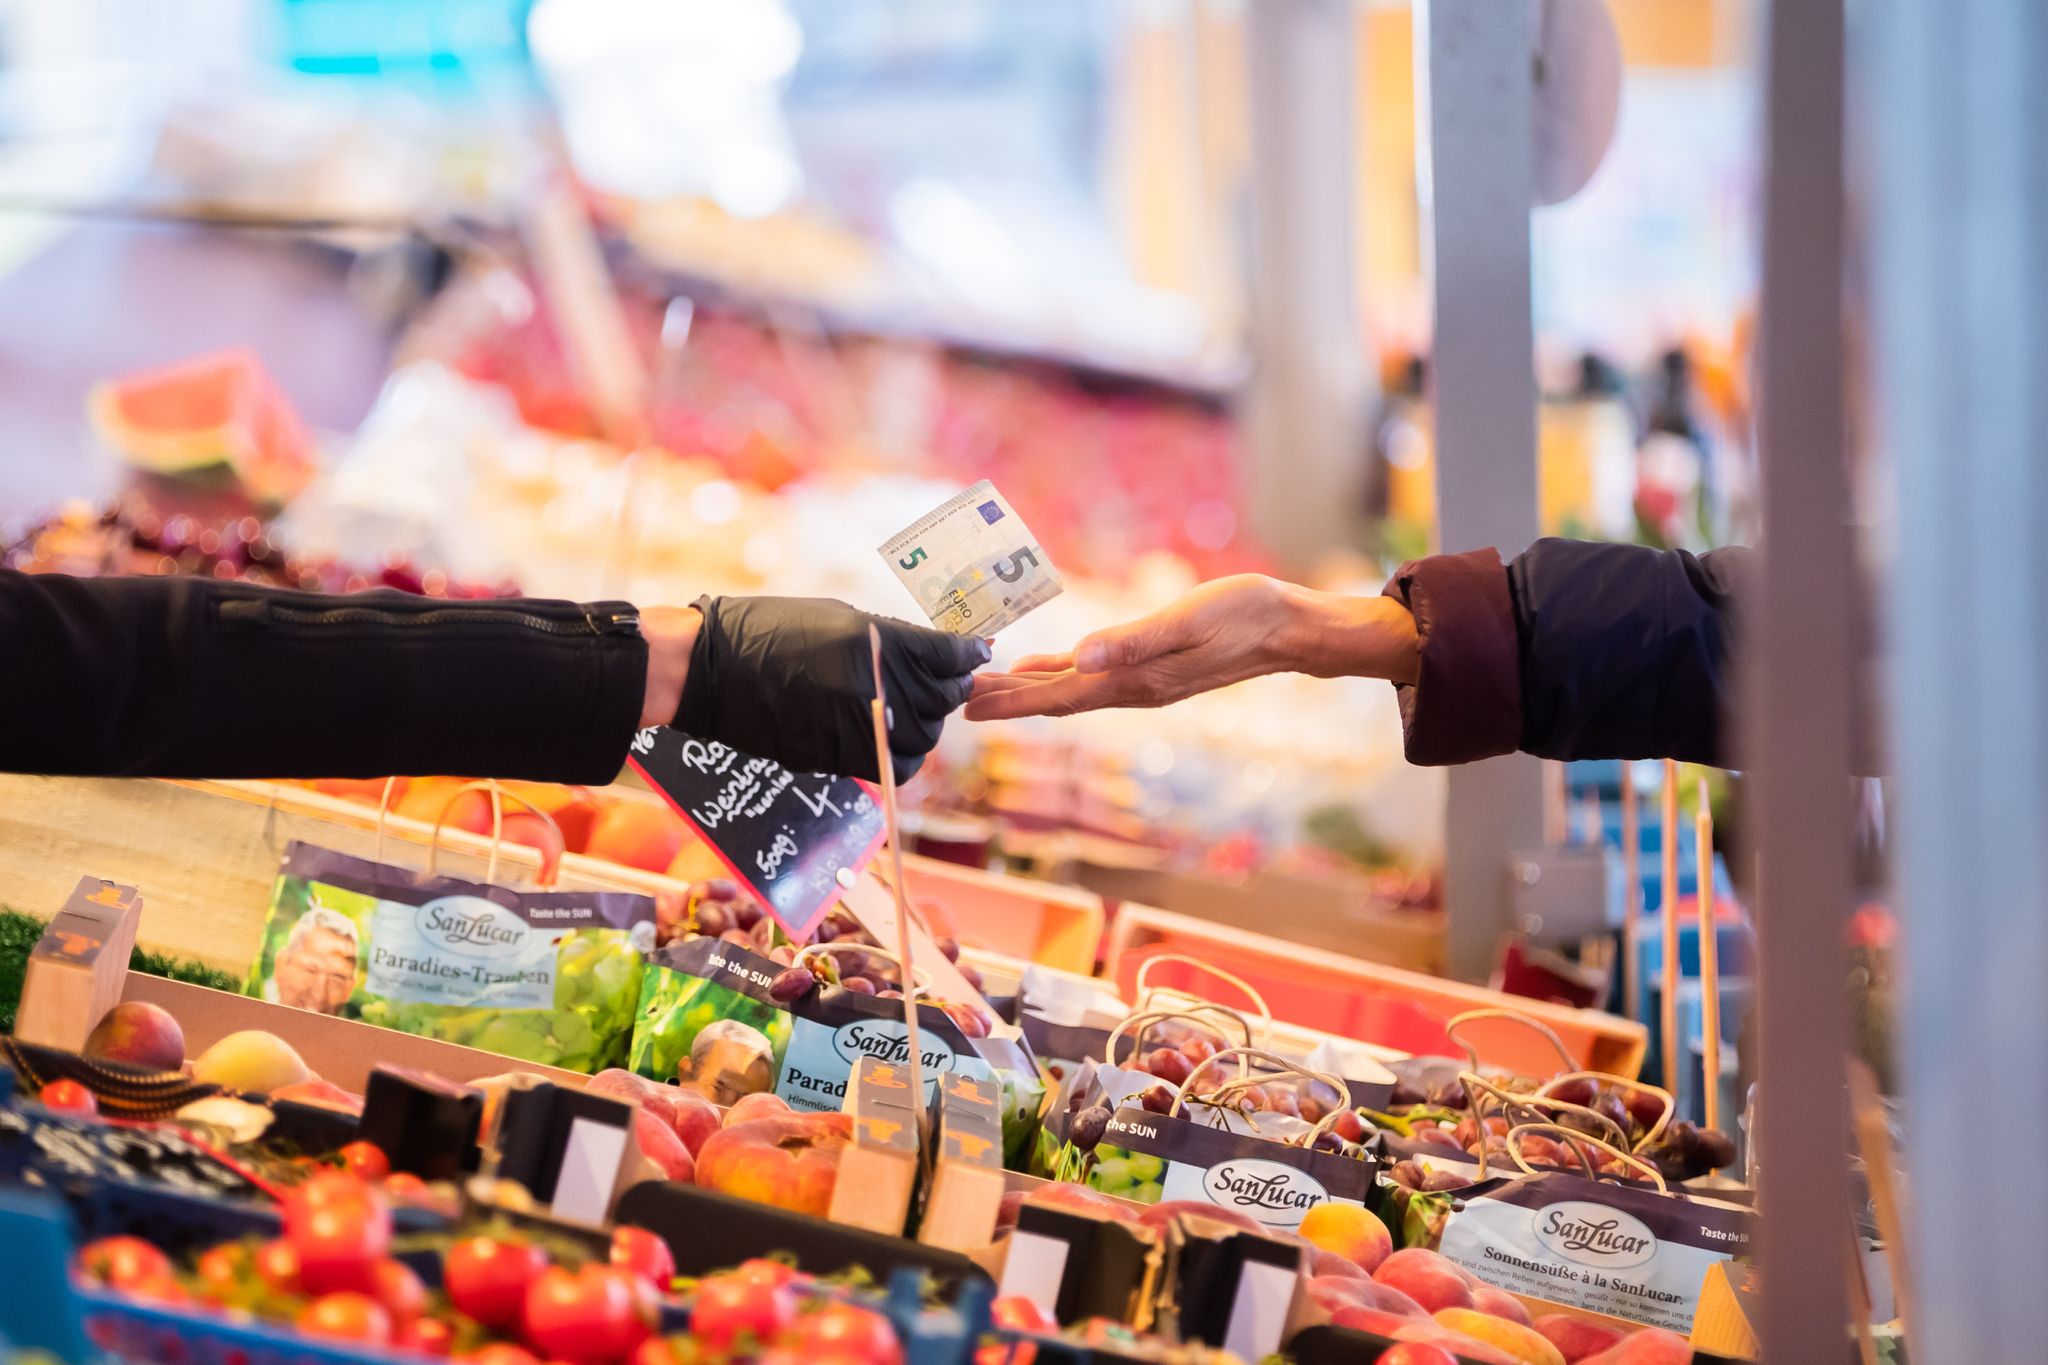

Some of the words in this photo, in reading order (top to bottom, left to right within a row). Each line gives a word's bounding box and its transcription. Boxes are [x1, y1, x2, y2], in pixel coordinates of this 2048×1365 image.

[899, 546, 928, 571] 5
[992, 545, 1039, 584] 5
[948, 589, 972, 618] EURO
[426, 906, 525, 946] SanLucar
[529, 908, 554, 919] Taste
[555, 908, 570, 919] the
[572, 908, 593, 919] SUN
[727, 961, 749, 978] the
[843, 1026, 948, 1069] SanLuar
[786, 1067, 848, 1098] Parad
[1128, 1123, 1157, 1139] SUN
[1214, 1167, 1322, 1210] SanLucar
[1543, 1210, 1650, 1254] SanLucar
[1700, 1225, 1727, 1240] Taste
[1727, 1231, 1740, 1242] the
[1483, 1246, 1578, 1281] Sonnensüße
[1581, 1270, 1590, 1284] à
[1594, 1273, 1608, 1288] la
[1611, 1278, 1683, 1305] SanLucar.
[1662, 1319, 1692, 1333] Geschm
